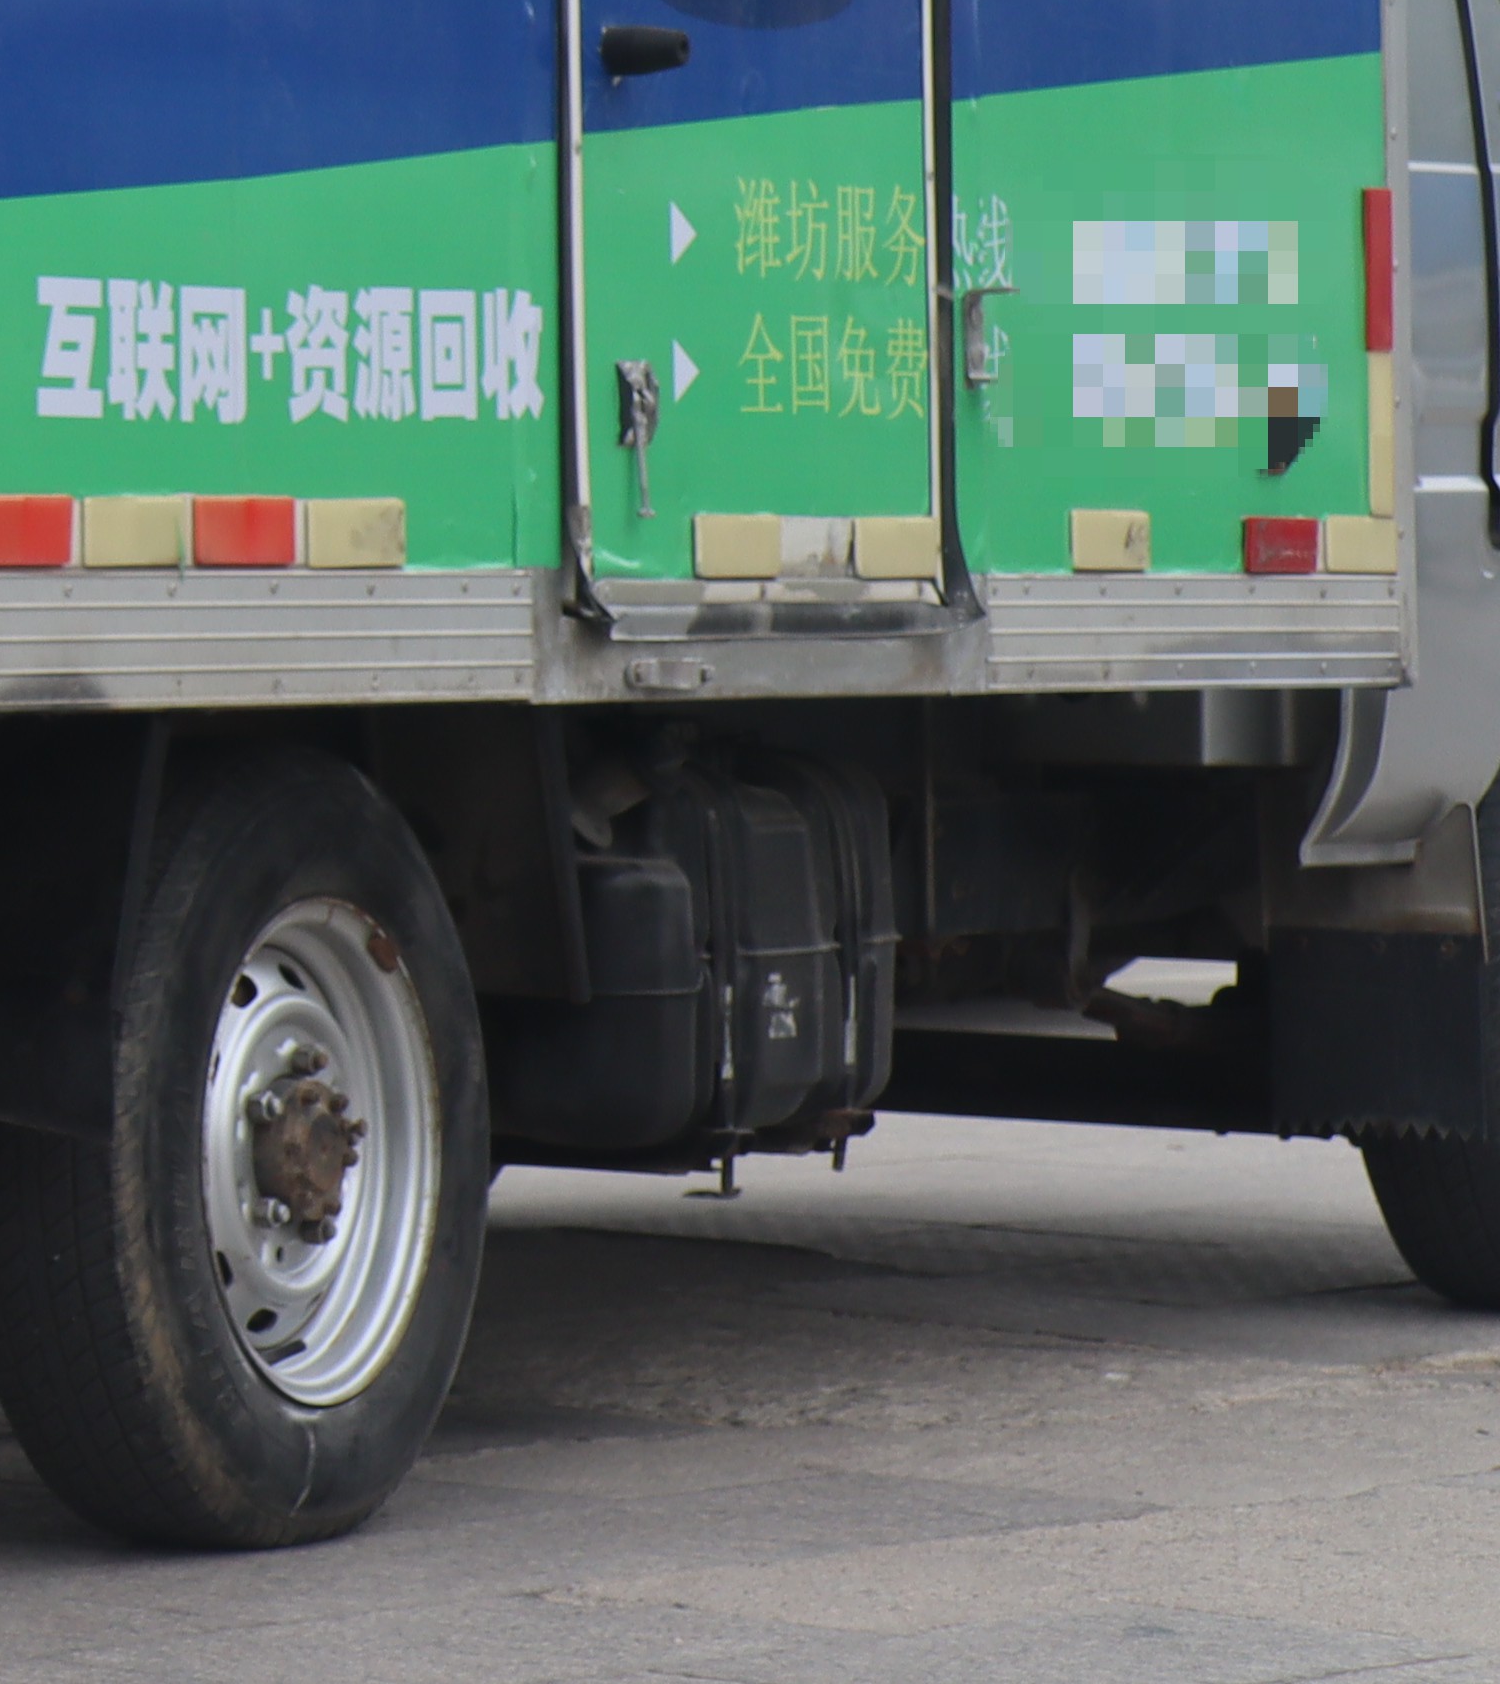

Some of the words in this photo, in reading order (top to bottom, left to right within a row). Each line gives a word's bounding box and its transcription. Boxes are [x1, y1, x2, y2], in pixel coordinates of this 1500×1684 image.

[35, 274, 546, 425] 互联网+资源回收
